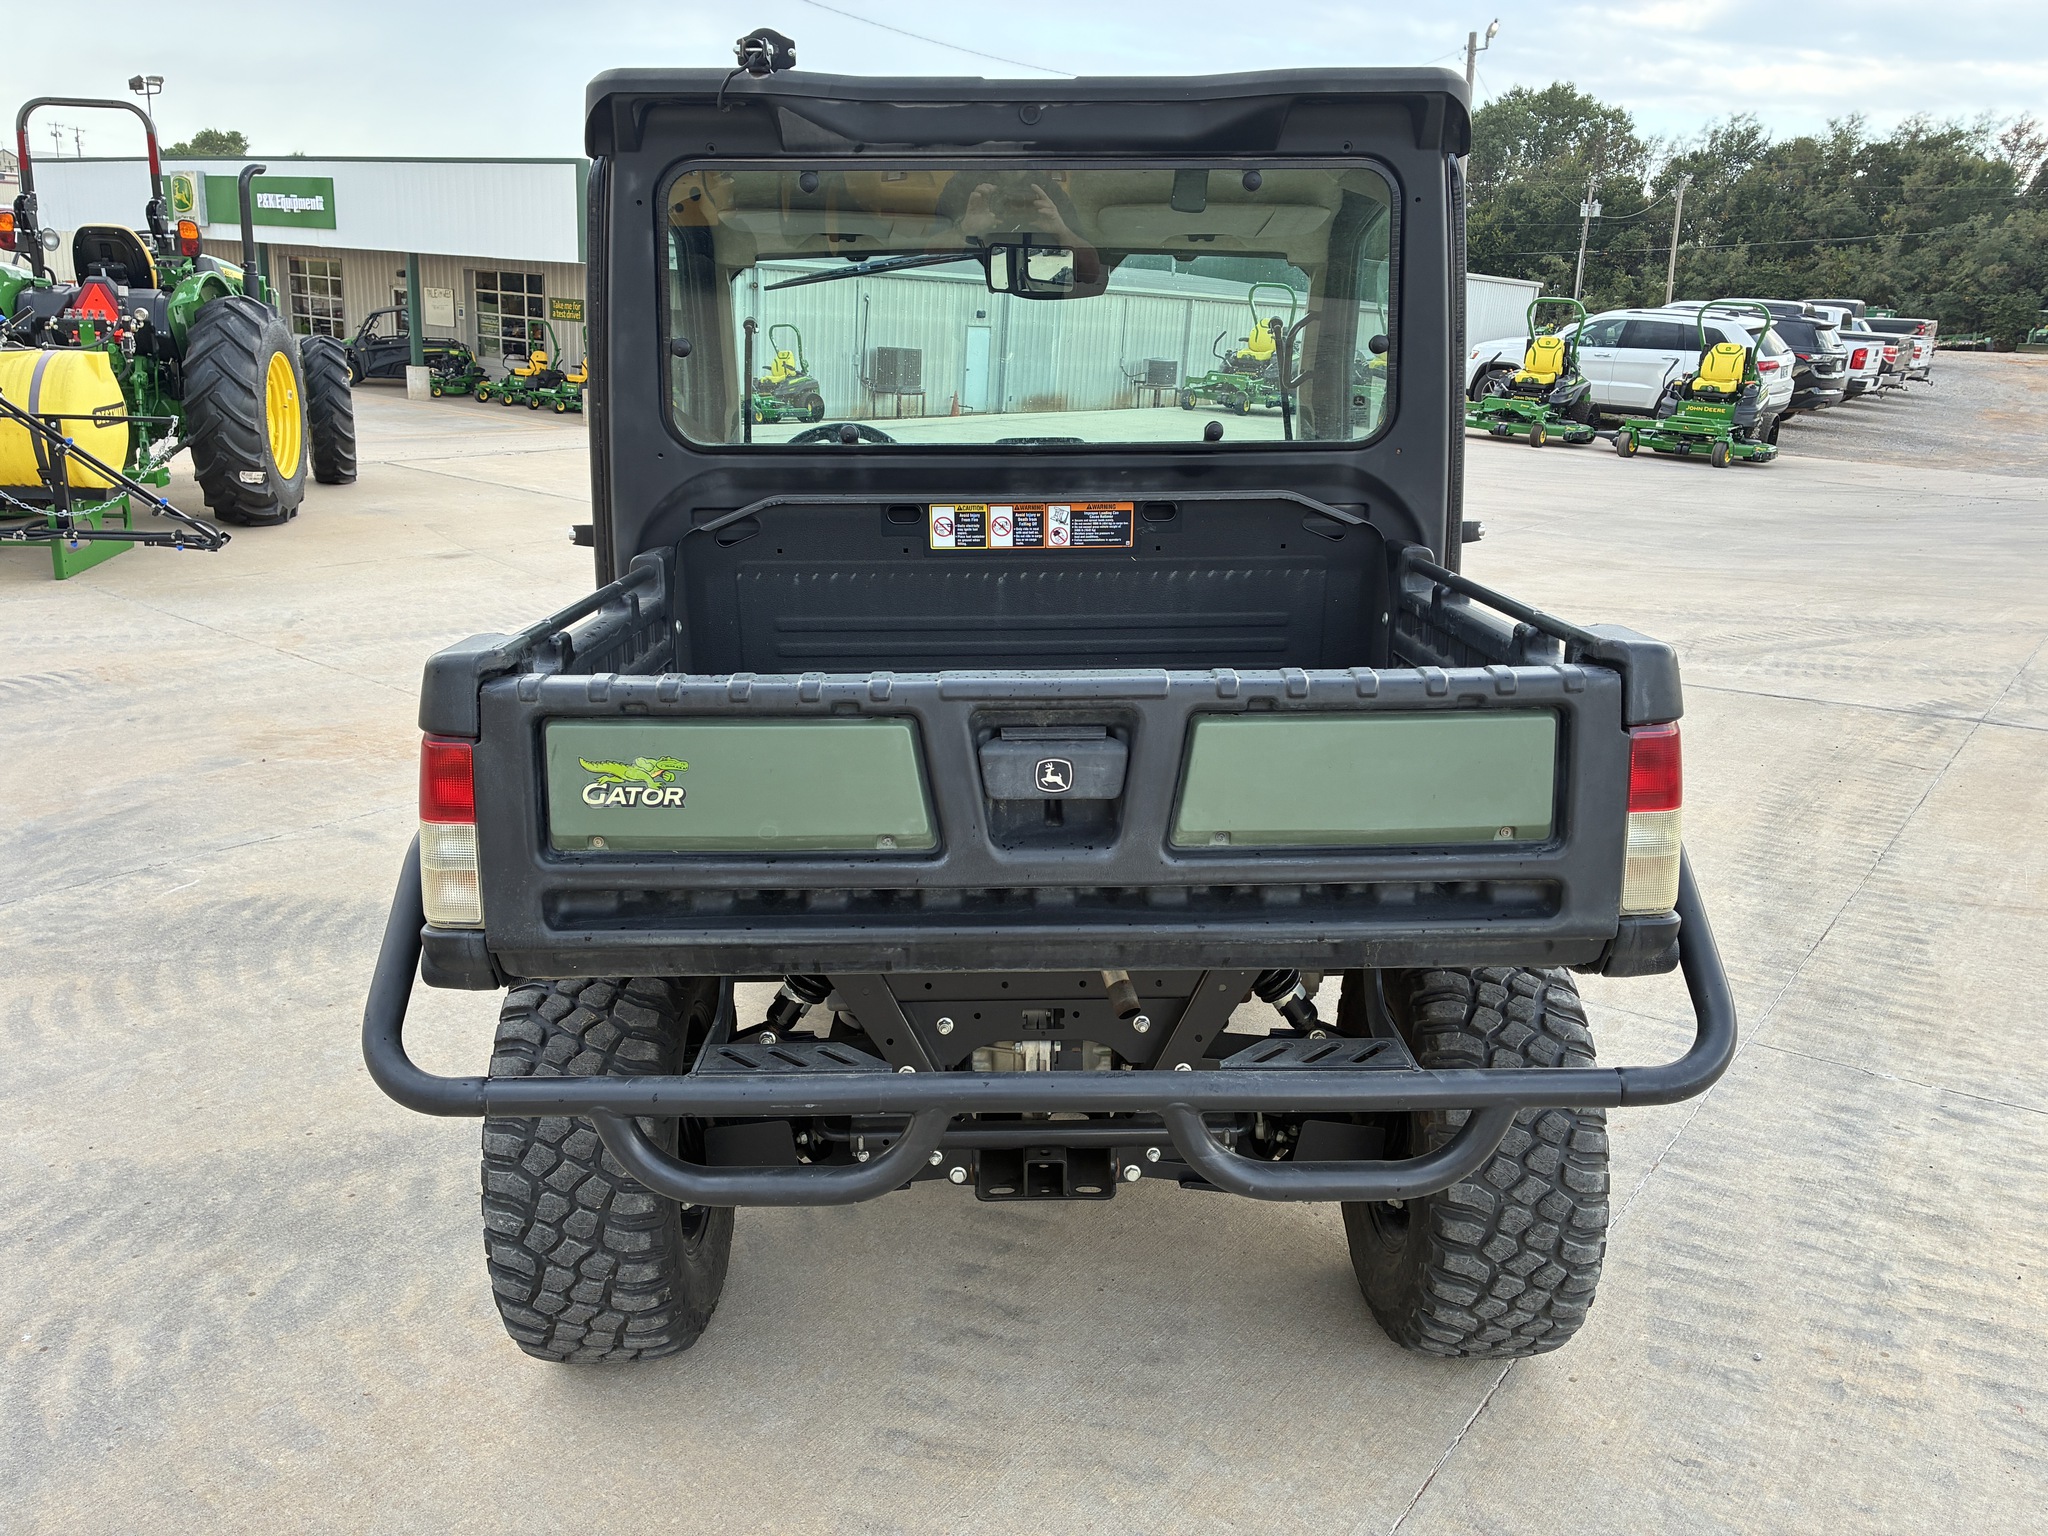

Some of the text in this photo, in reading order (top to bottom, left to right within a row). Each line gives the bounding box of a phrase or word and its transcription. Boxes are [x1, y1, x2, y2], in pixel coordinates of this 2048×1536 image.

[257, 193, 274, 208] P&K
[276, 194, 319, 212] Equipment
[552, 300, 564, 309] Take
[573, 301, 581, 310] for
[556, 310, 566, 318] test
[582, 782, 685, 807] GATOR
